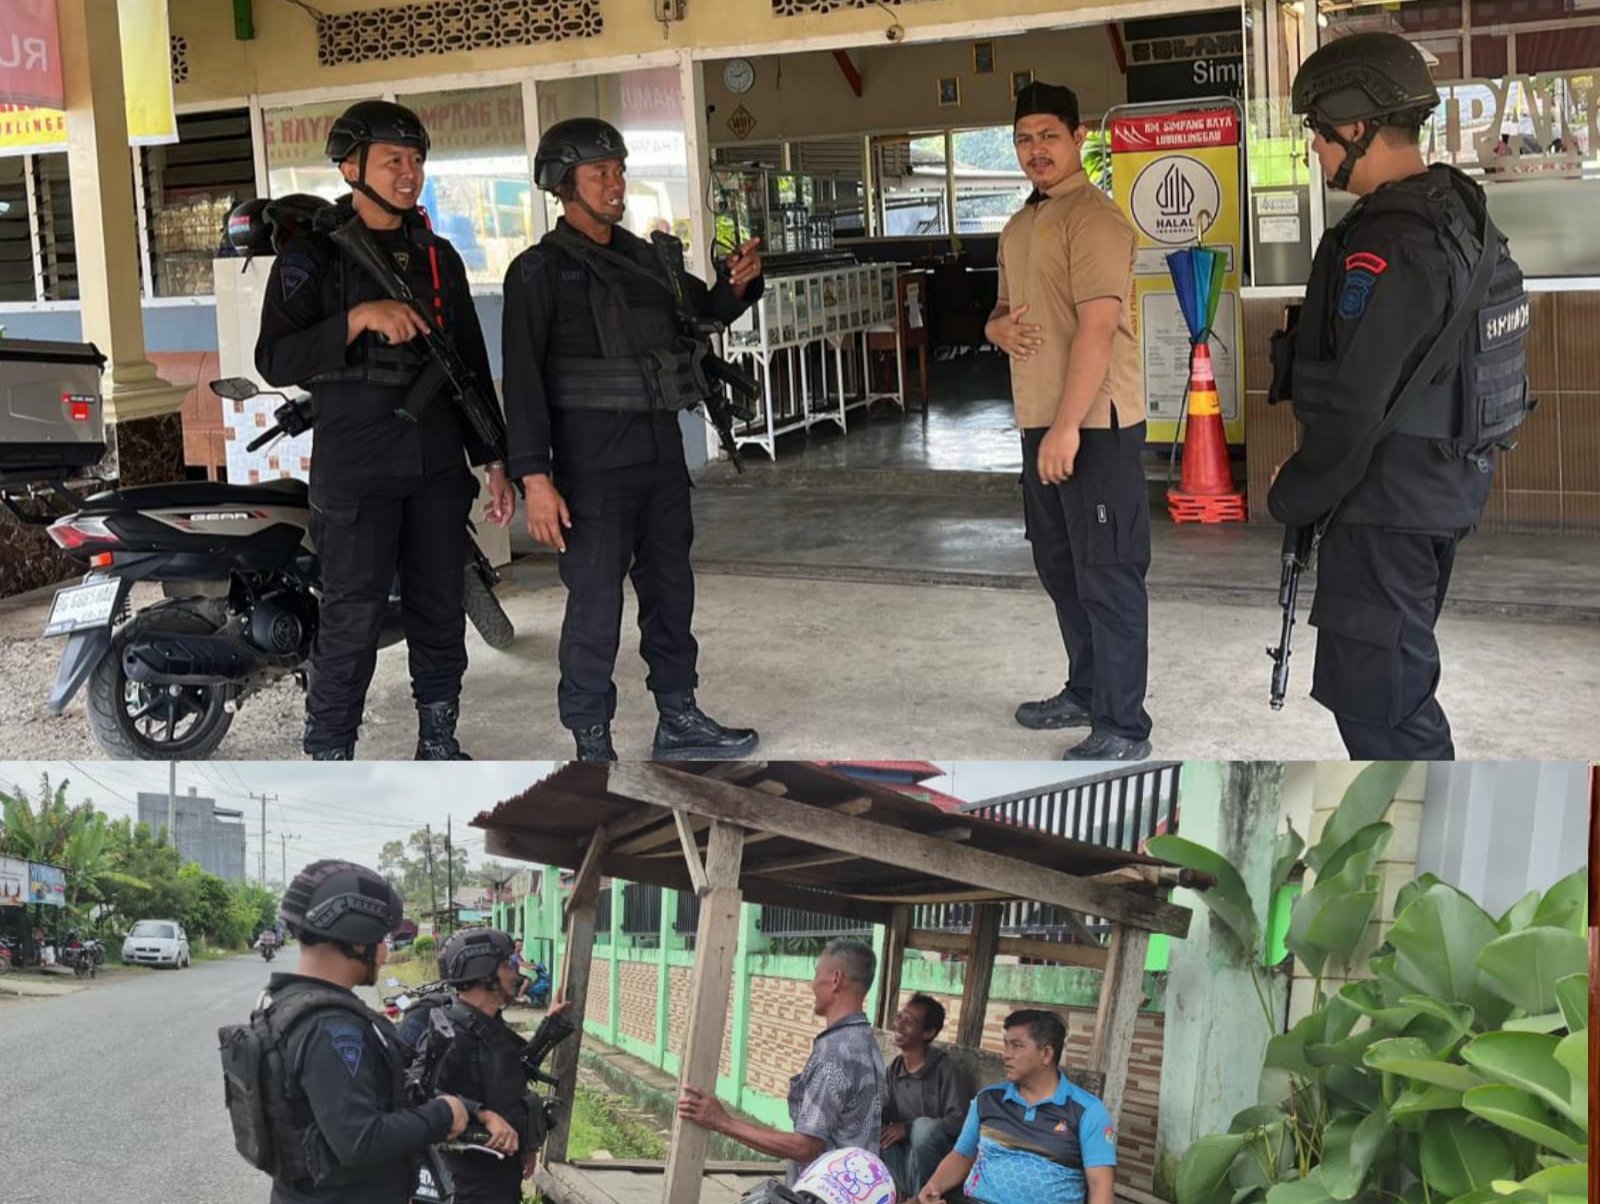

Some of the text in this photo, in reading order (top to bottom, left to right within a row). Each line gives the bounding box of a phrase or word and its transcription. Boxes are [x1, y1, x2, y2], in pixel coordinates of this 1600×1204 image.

[1163, 118, 1204, 132] SIMPANG
[1206, 116, 1232, 128] RAYA
[1156, 130, 1221, 145] LUBUKLINGGAU
[1156, 218, 1195, 229] HALAL
[190, 513, 248, 521] GEAR
